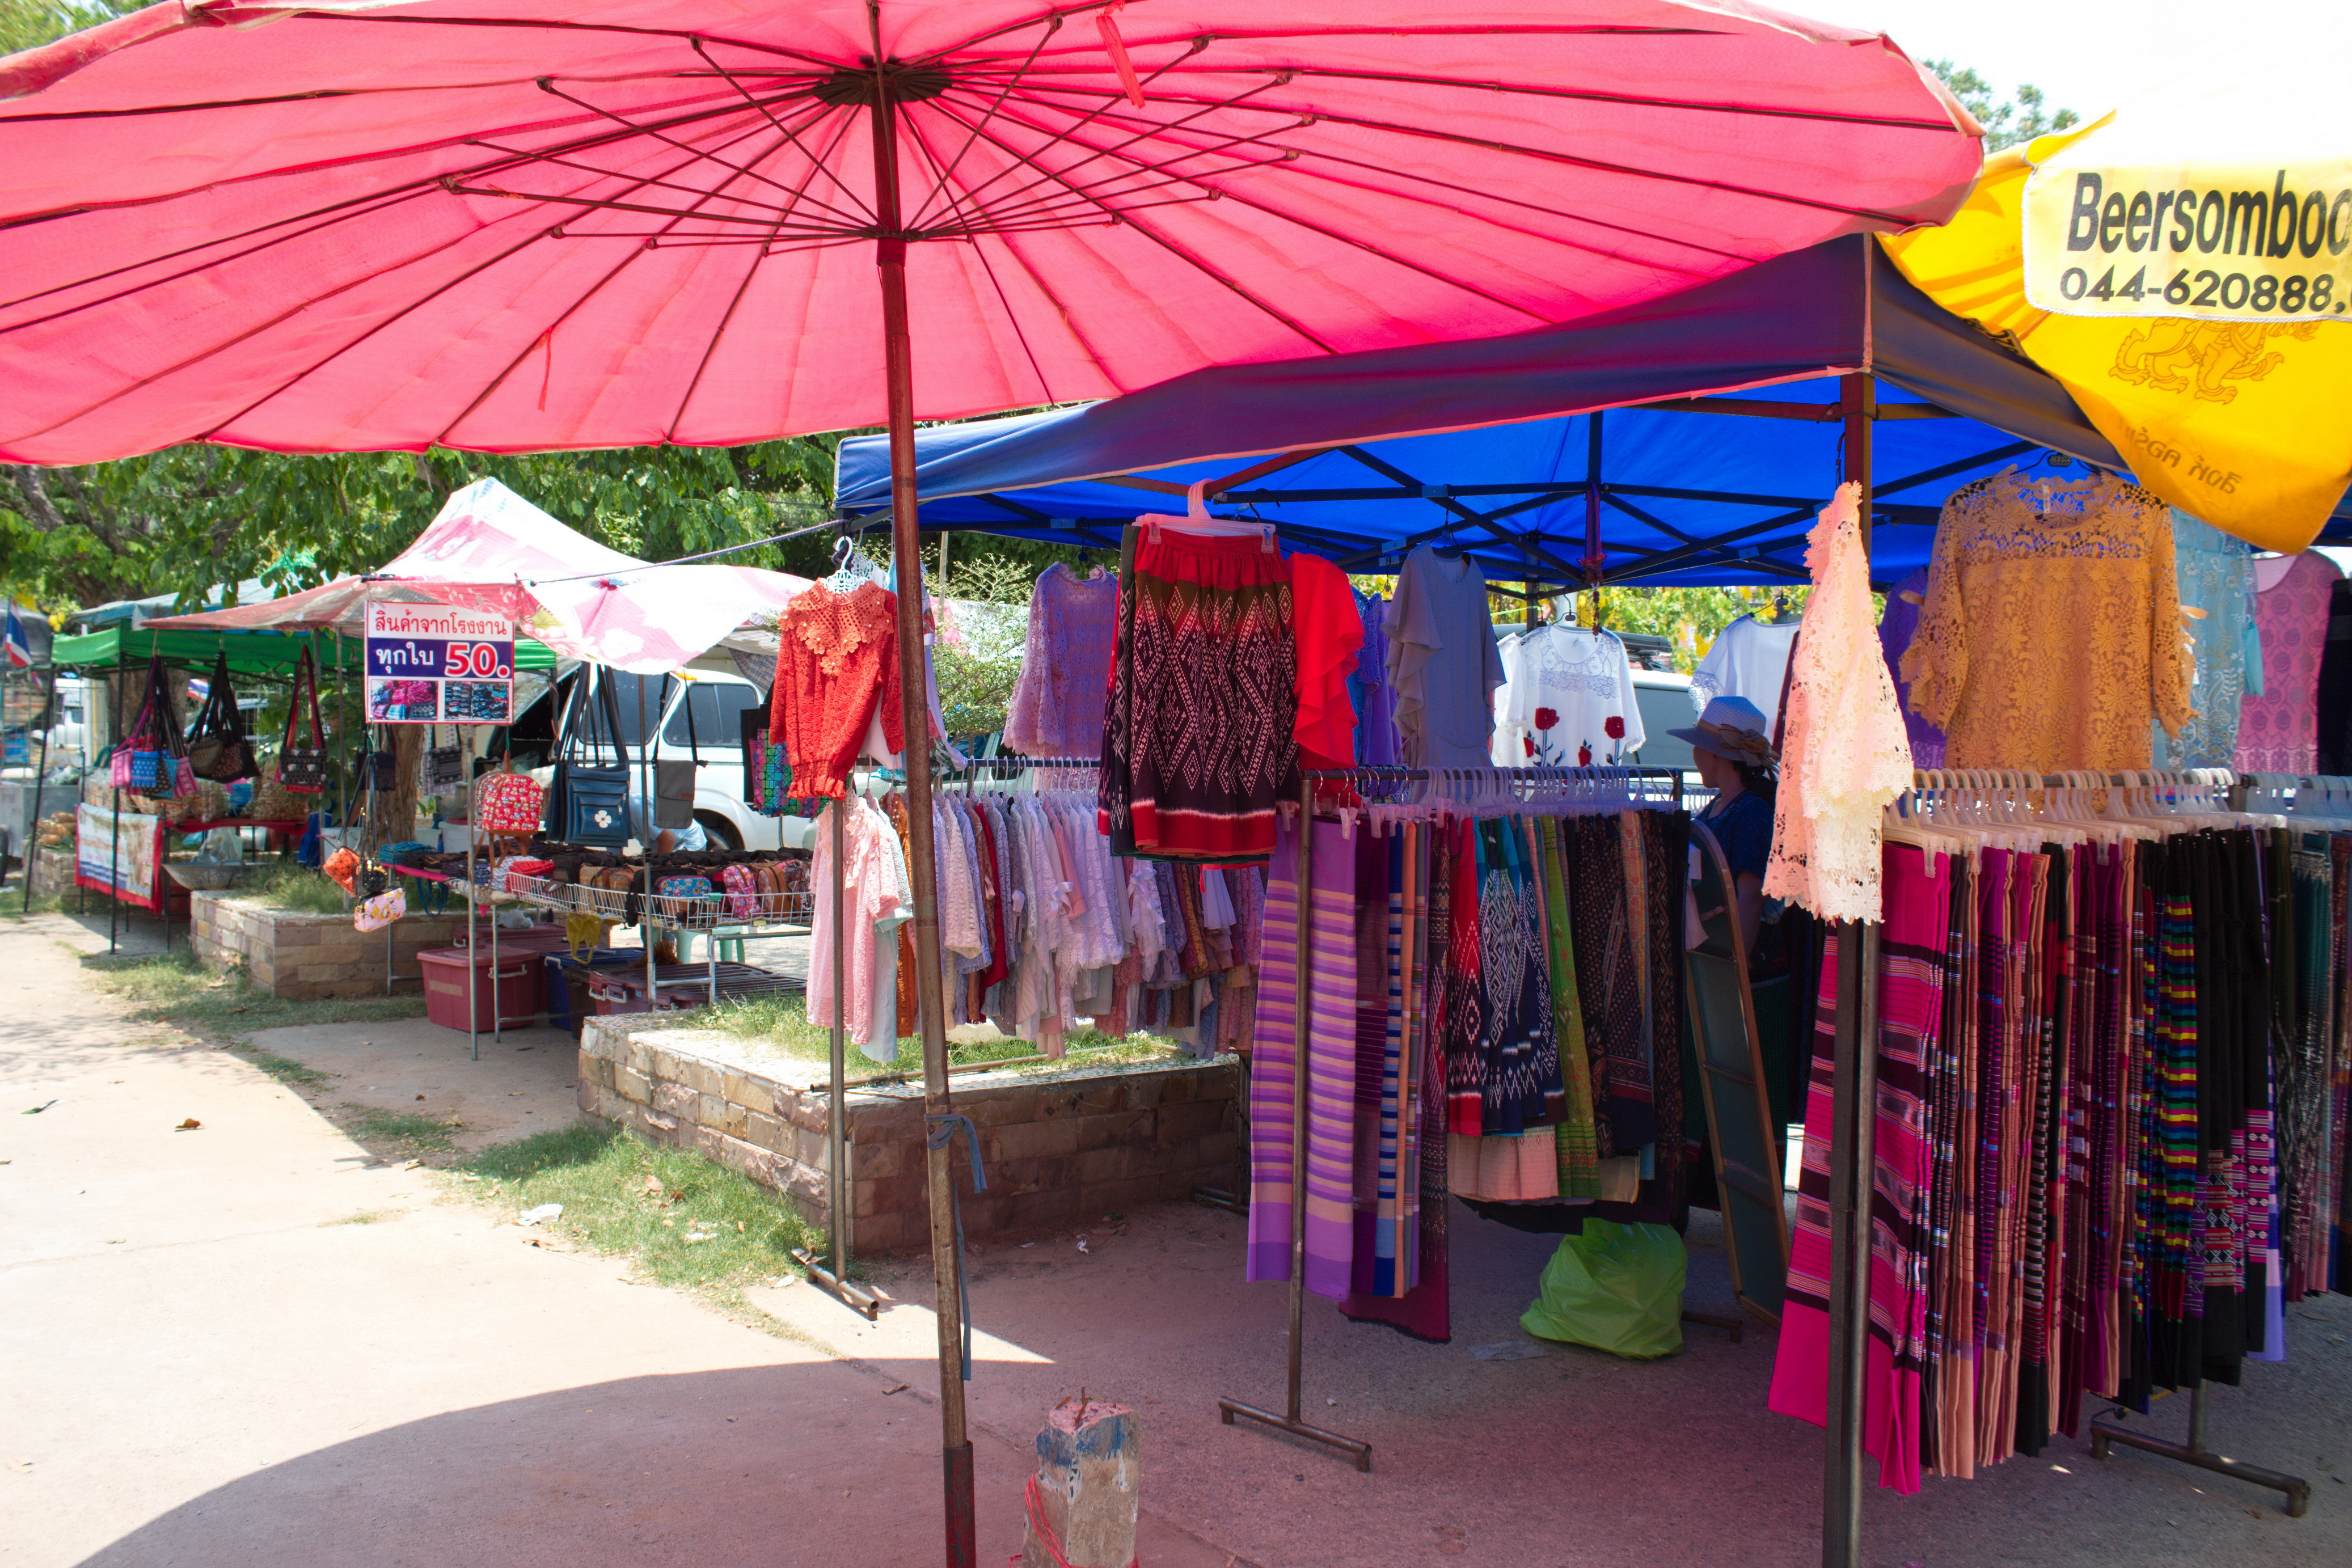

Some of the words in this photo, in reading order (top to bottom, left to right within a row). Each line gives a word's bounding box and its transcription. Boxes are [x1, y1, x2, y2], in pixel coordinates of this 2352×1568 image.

[2060, 264, 2352, 314] 044-620888,
[375, 609, 507, 635] สินค้าจากโรงงาน
[376, 642, 434, 674] ทุกใบ
[445, 642, 510, 678] 50.
